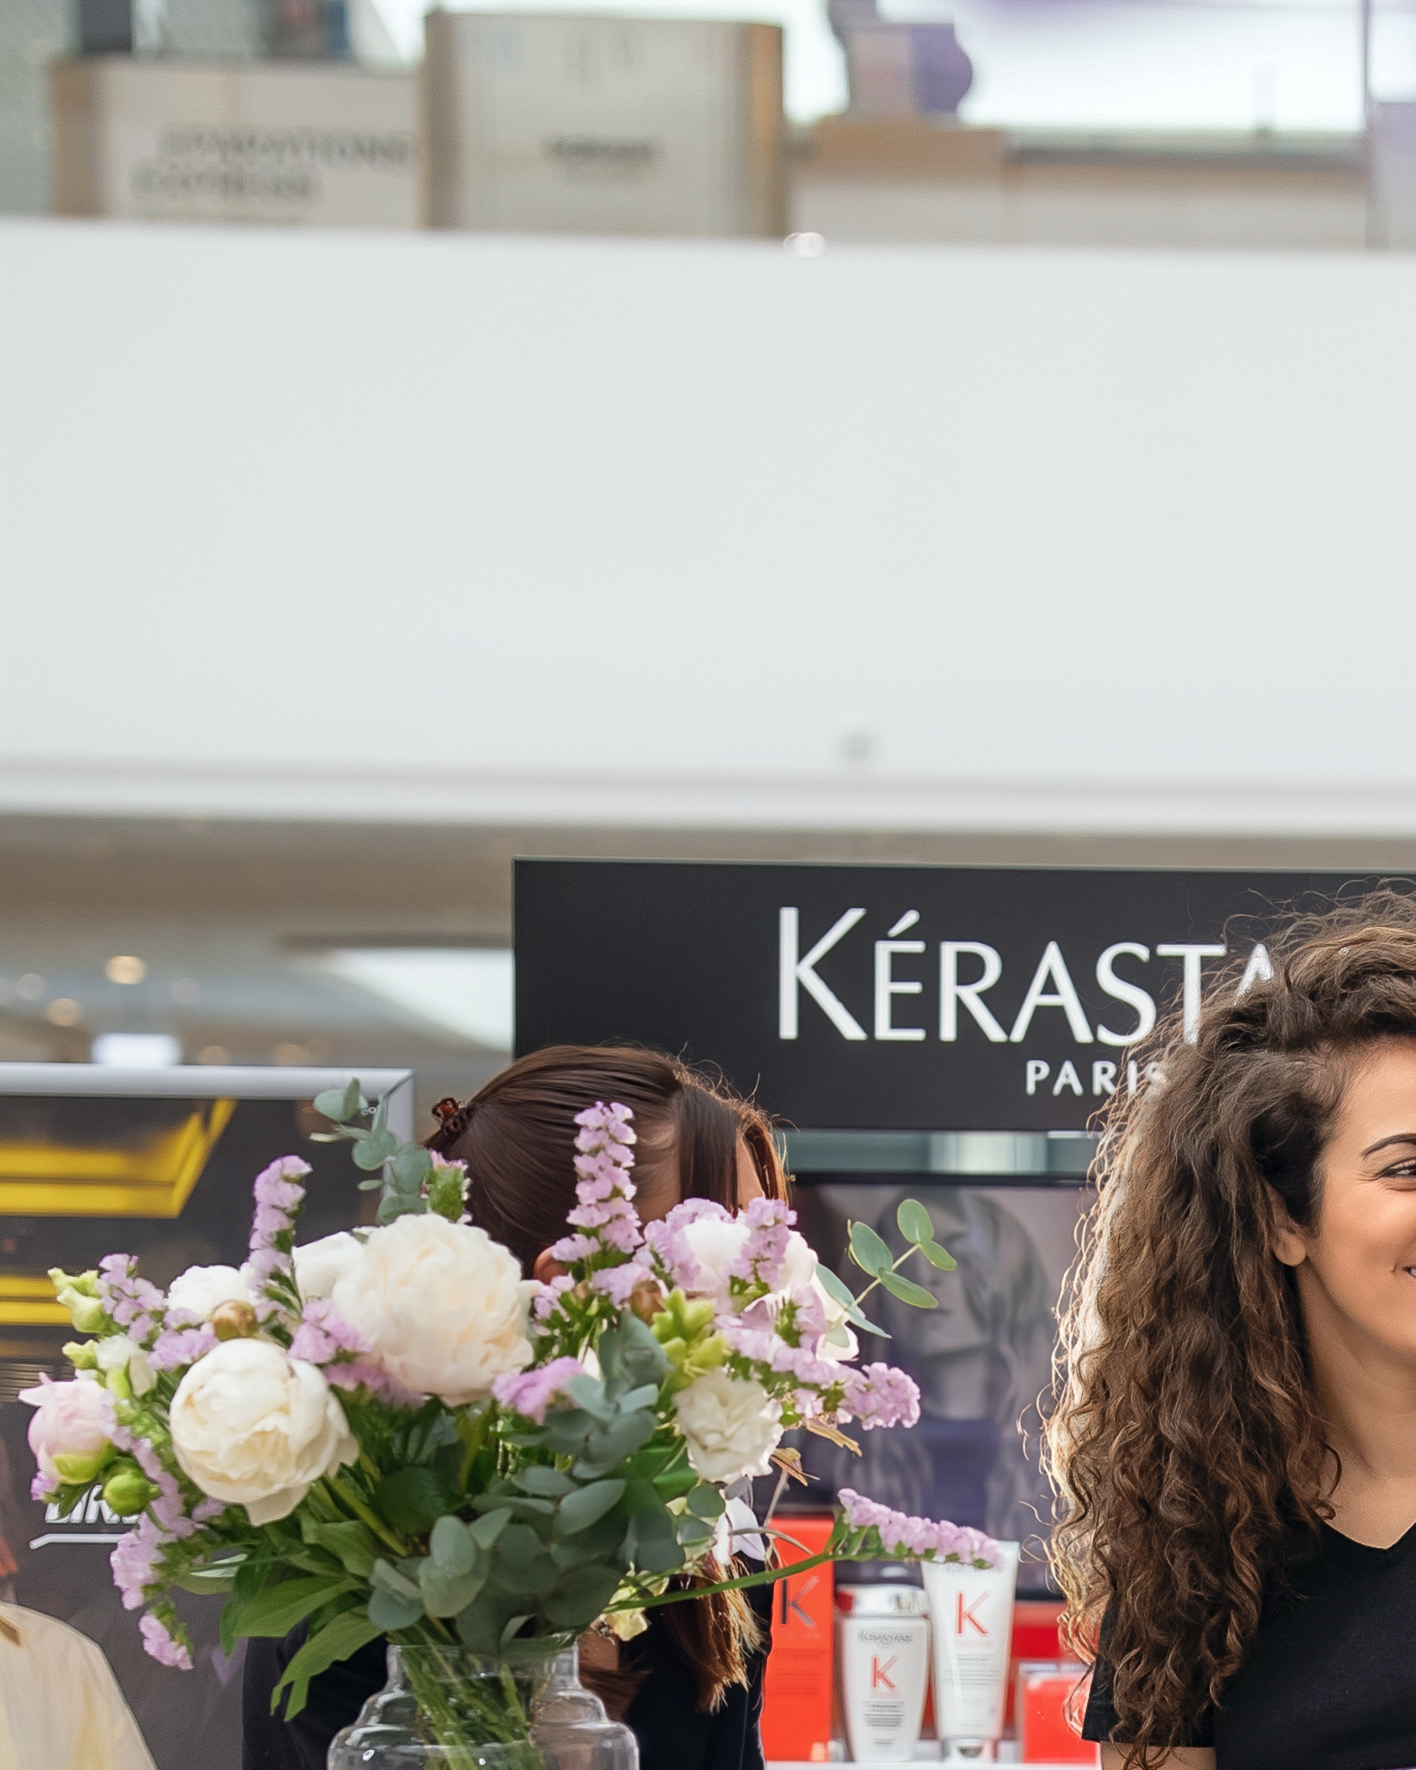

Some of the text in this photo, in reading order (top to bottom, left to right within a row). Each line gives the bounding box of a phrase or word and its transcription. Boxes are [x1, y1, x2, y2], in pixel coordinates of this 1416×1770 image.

[781, 1575, 820, 1627] K
[957, 1590, 990, 1635] K
[871, 1654, 898, 1690] K
